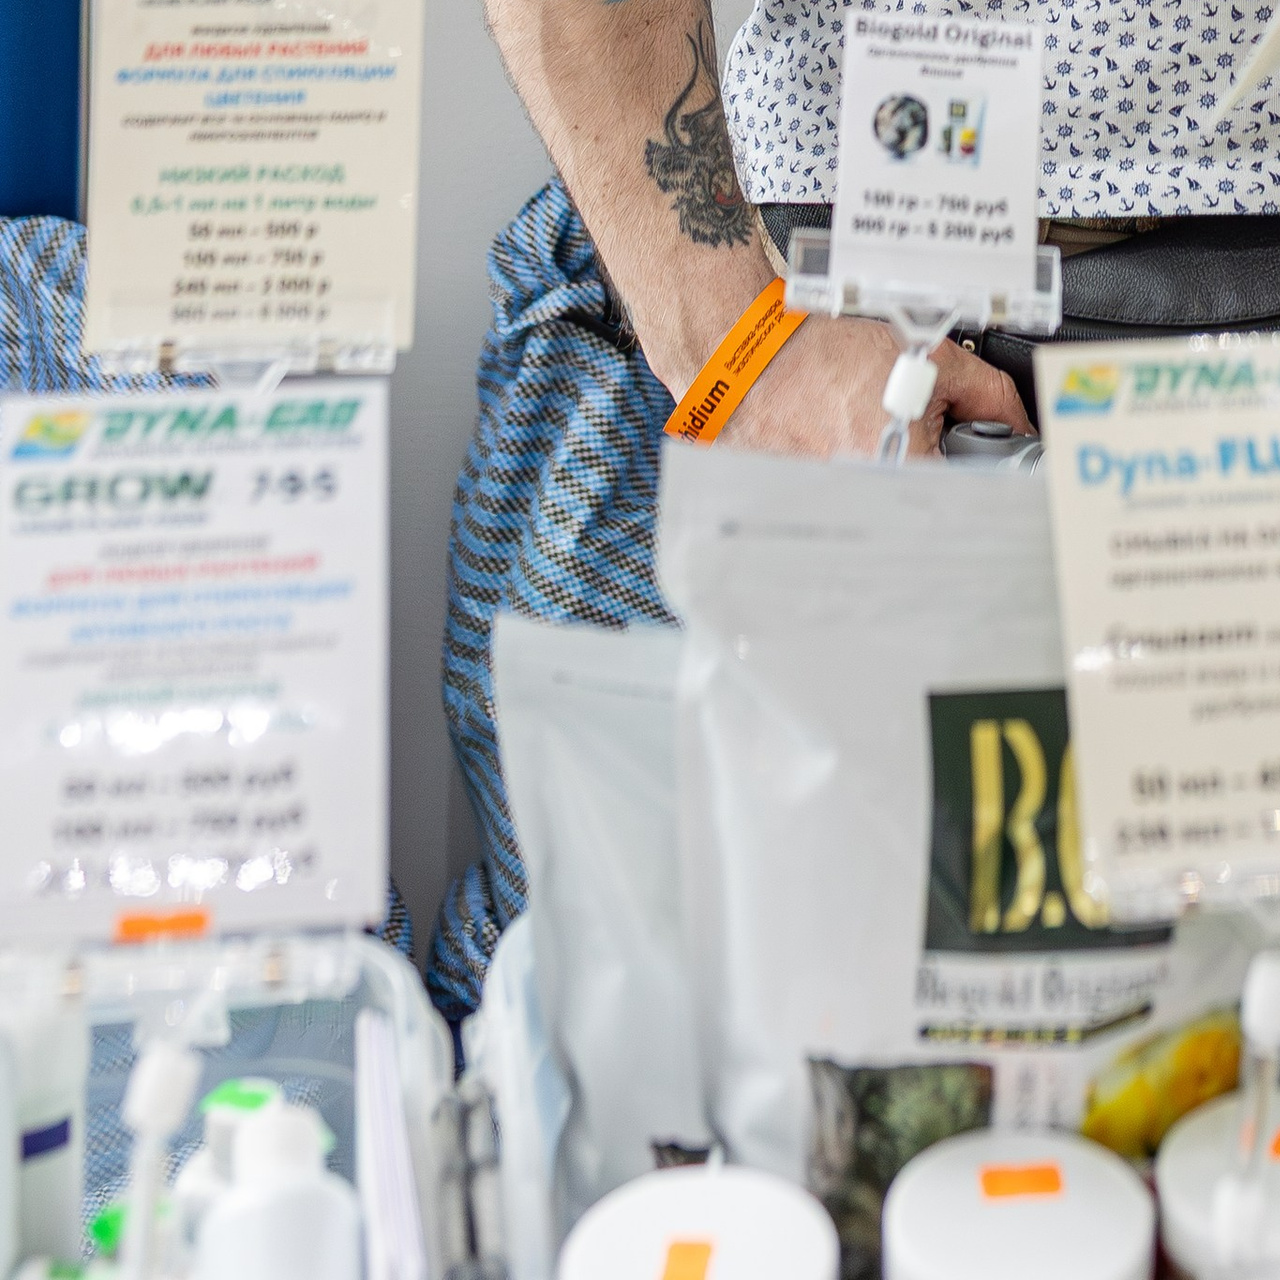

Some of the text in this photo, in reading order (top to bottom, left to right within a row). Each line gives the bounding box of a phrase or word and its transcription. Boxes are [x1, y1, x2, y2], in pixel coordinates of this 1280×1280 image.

[855, 16, 1034, 50] Biogold Original
[723, 298, 783, 371] Выставка-ярмарка
[677, 378, 731, 445] hidium
[12, 467, 215, 512] GROW
